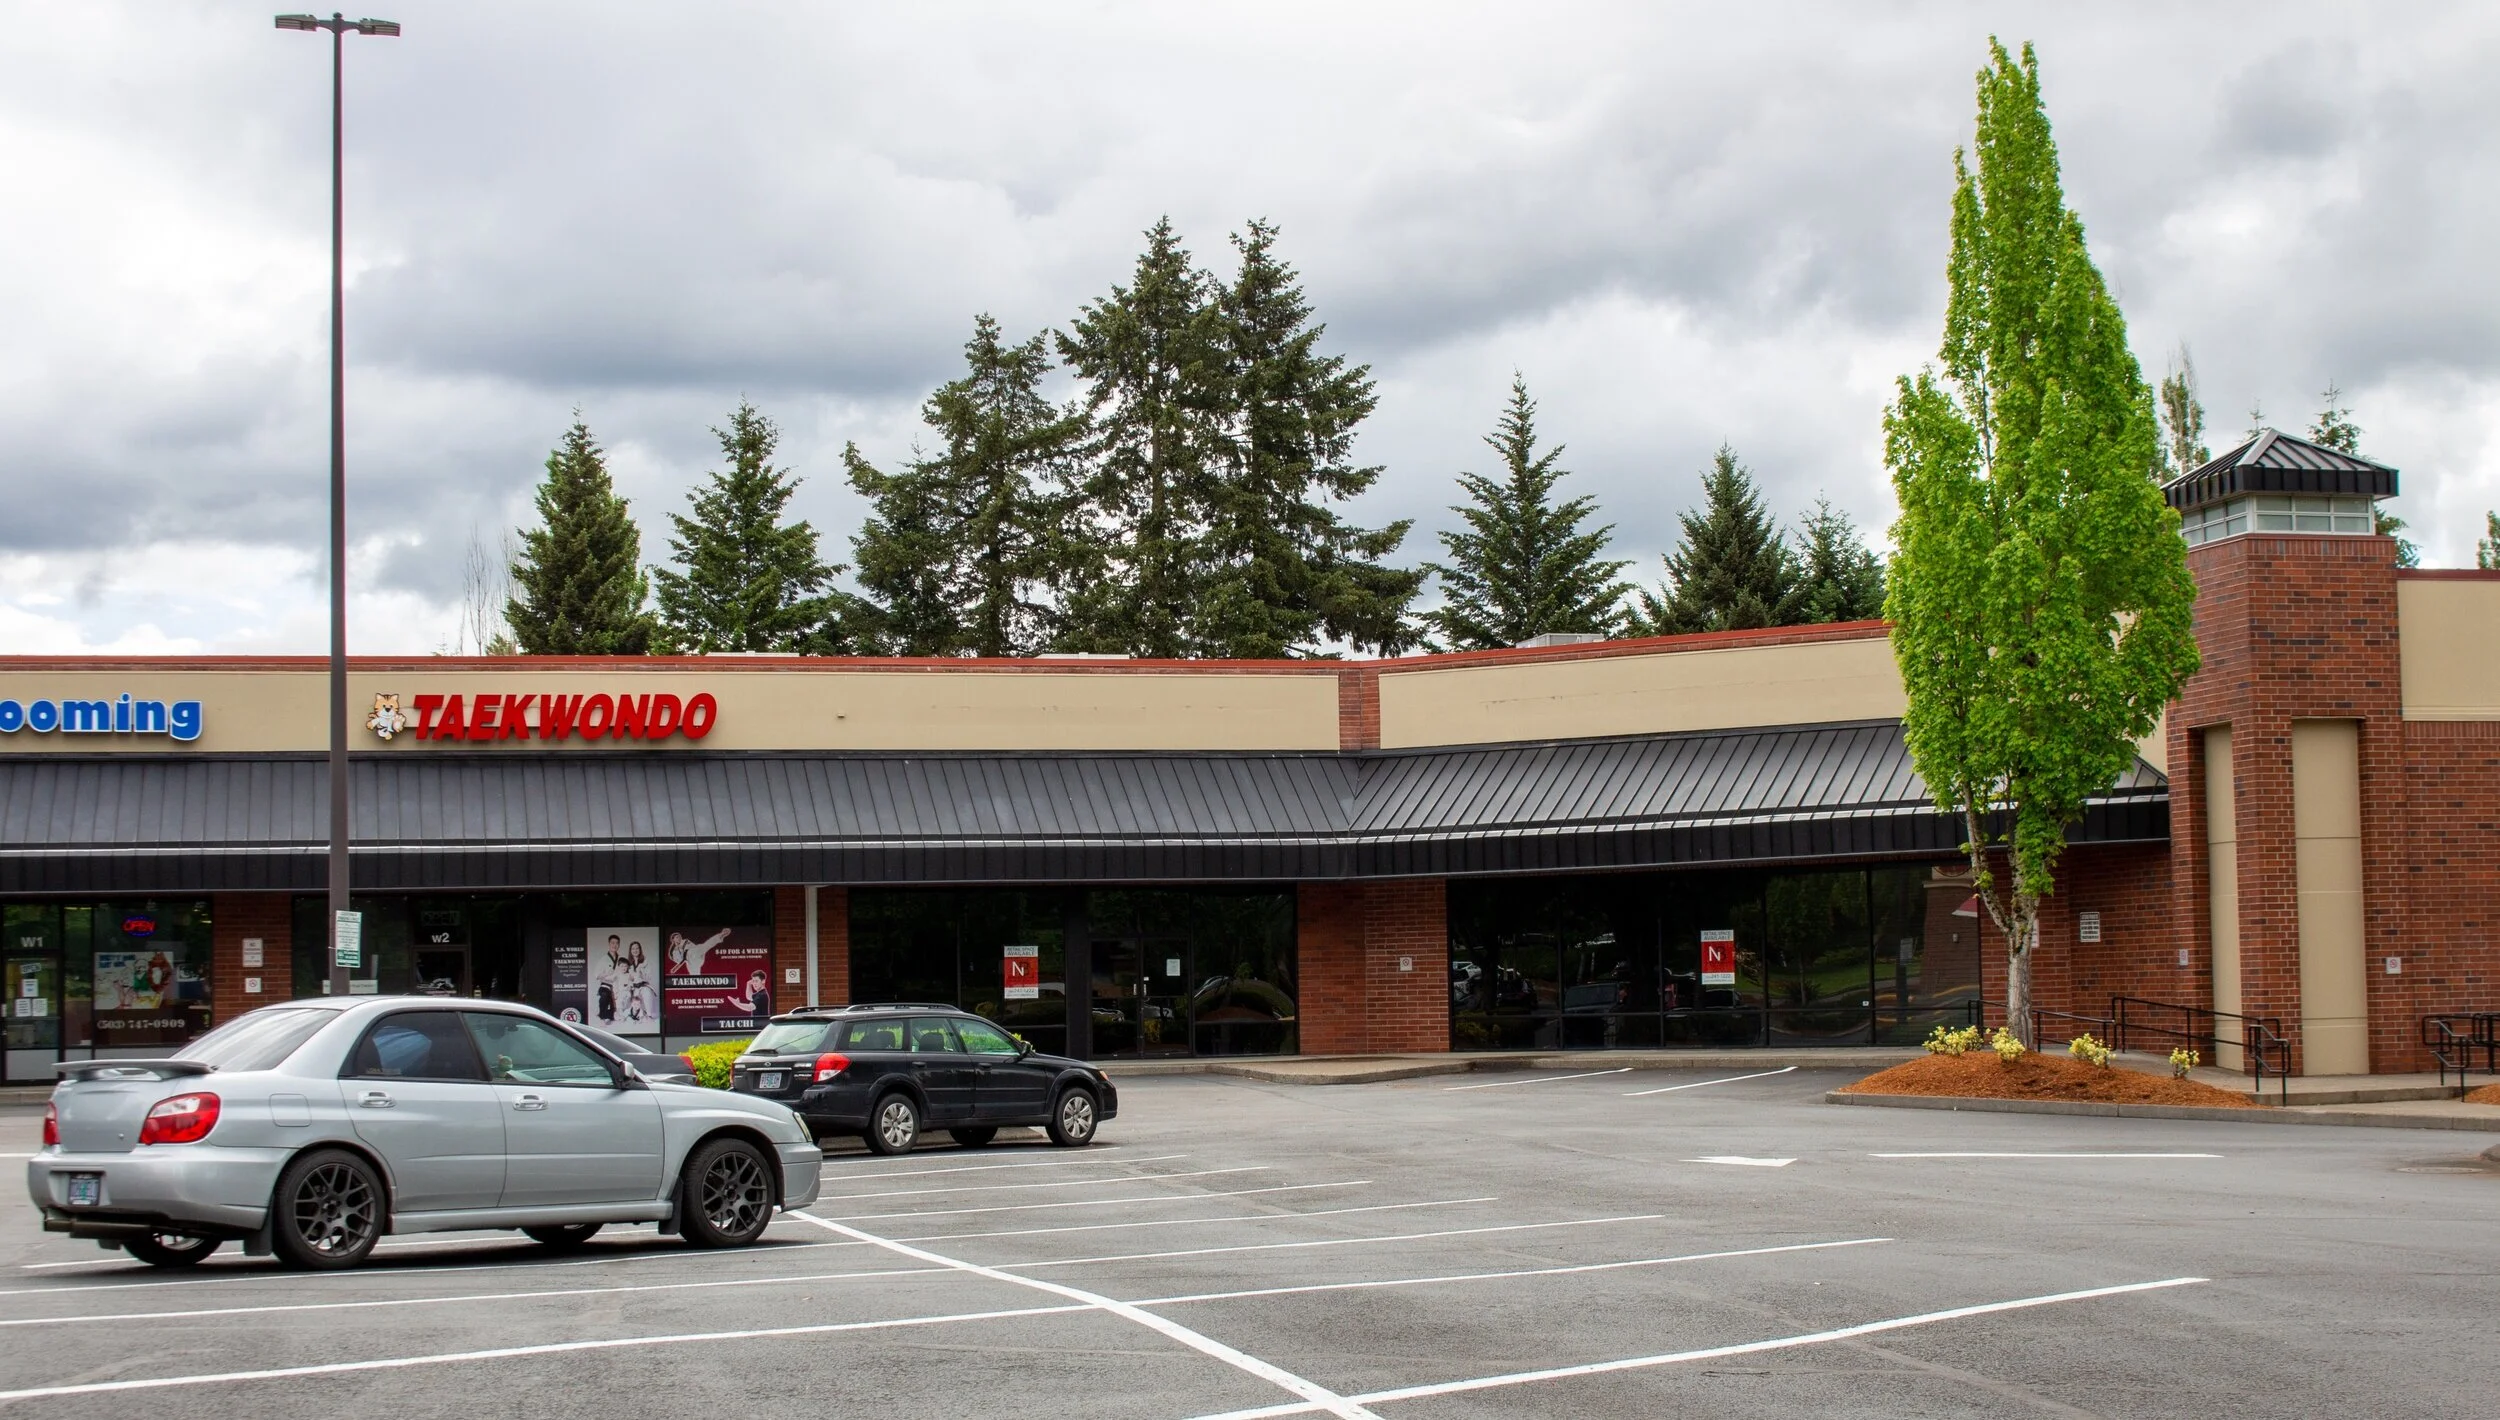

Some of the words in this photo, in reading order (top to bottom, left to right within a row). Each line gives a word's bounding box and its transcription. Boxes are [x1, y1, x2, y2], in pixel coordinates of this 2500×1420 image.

[0, 692, 202, 741] ooming
[413, 693, 718, 740] TAEKWONDO
[122, 919, 156, 932] OPEN
[21, 936, 43, 948] W1
[671, 977, 729, 986] TAEKWONDO
[127, 1019, 186, 1029] 747-0909
[719, 1020, 736, 1028] TAI
[737, 1020, 754, 1028] CHI
